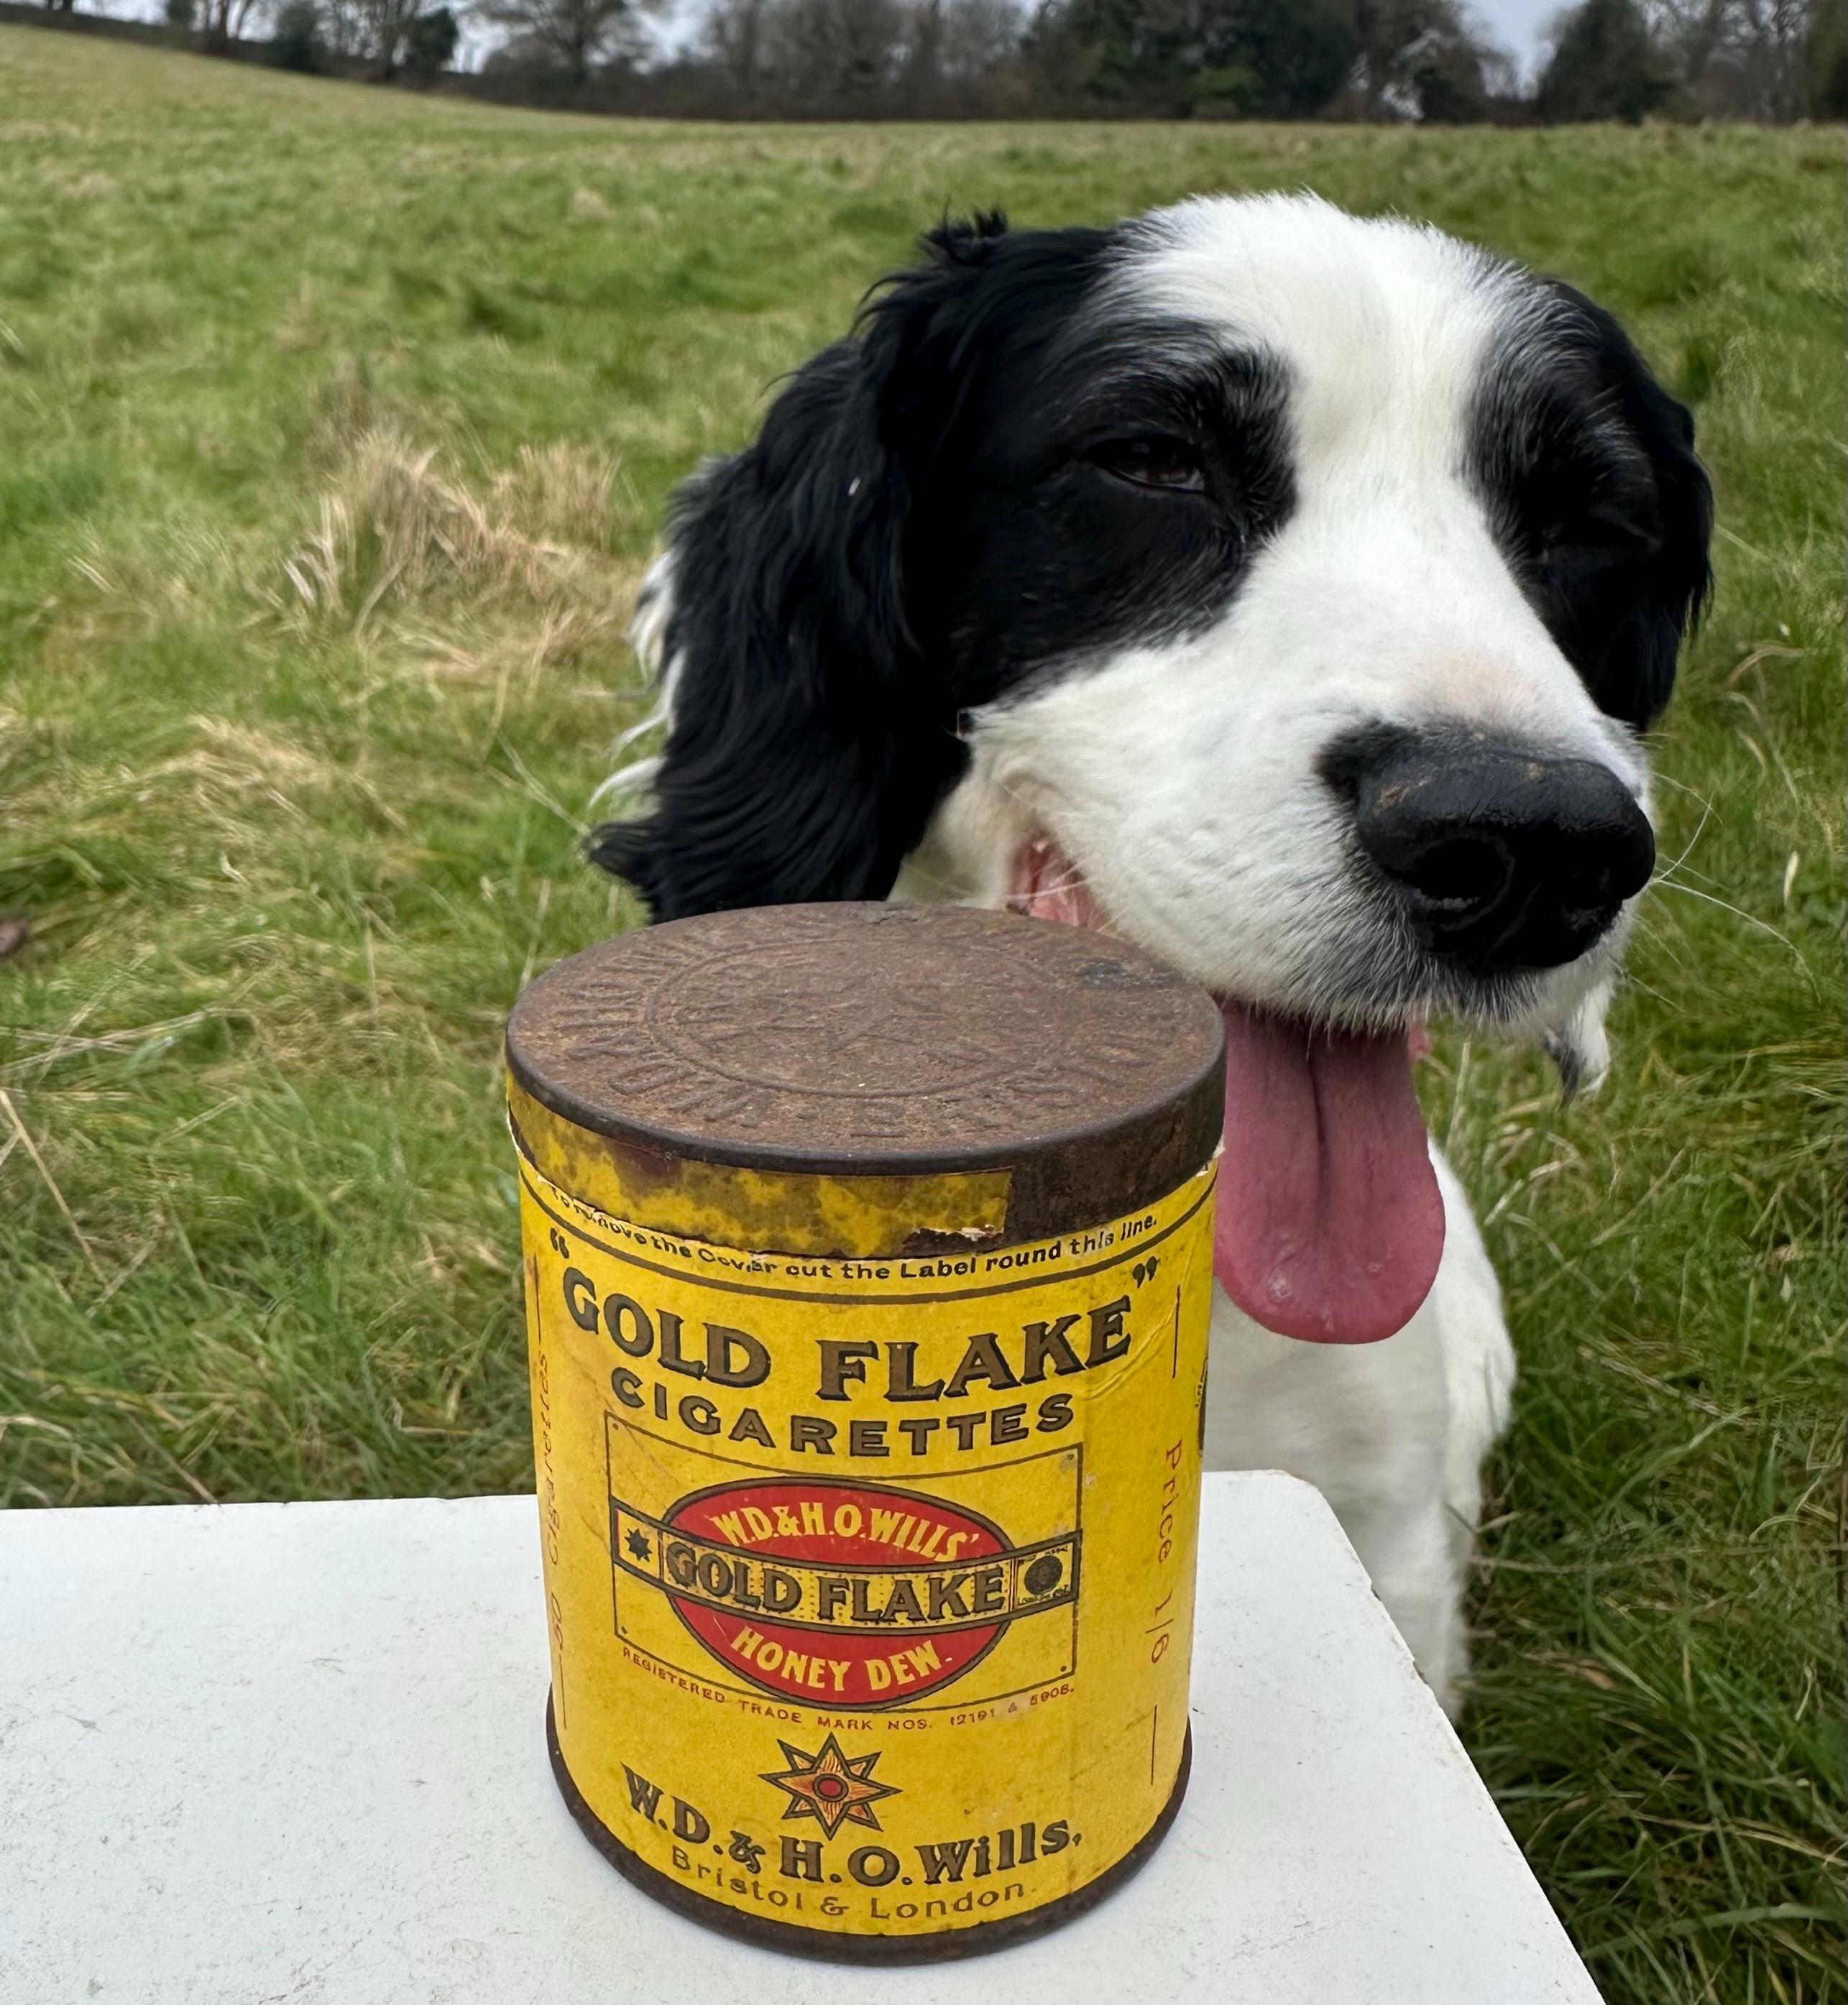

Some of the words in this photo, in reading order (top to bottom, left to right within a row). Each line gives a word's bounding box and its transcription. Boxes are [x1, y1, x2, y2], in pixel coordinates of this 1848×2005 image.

[651, 1235, 692, 1258] the
[786, 1263, 832, 1278] cut
[841, 1263, 890, 1279] the
[901, 1257, 976, 1278] Label
[985, 1240, 1062, 1272] round
[1069, 1231, 1114, 1255] this
[1121, 1214, 1158, 1240] line.
[610, 1366, 1075, 1457] CIGARETTES
[1159, 1438, 1183, 1564] Price
[666, 1542, 803, 1614] GOLD
[817, 1563, 1005, 1623] FLAKE
[730, 1625, 852, 1692] HONEY
[1145, 1589, 1174, 1664] 1/6
[622, 1646, 726, 1703] REGISTERED
[738, 1699, 803, 1723] TRADE
[817, 1716, 873, 1730] MARK
[888, 1718, 933, 1730] NOS.
[671, 1845, 803, 1911] Bristol
[819, 1896, 850, 1916] &
